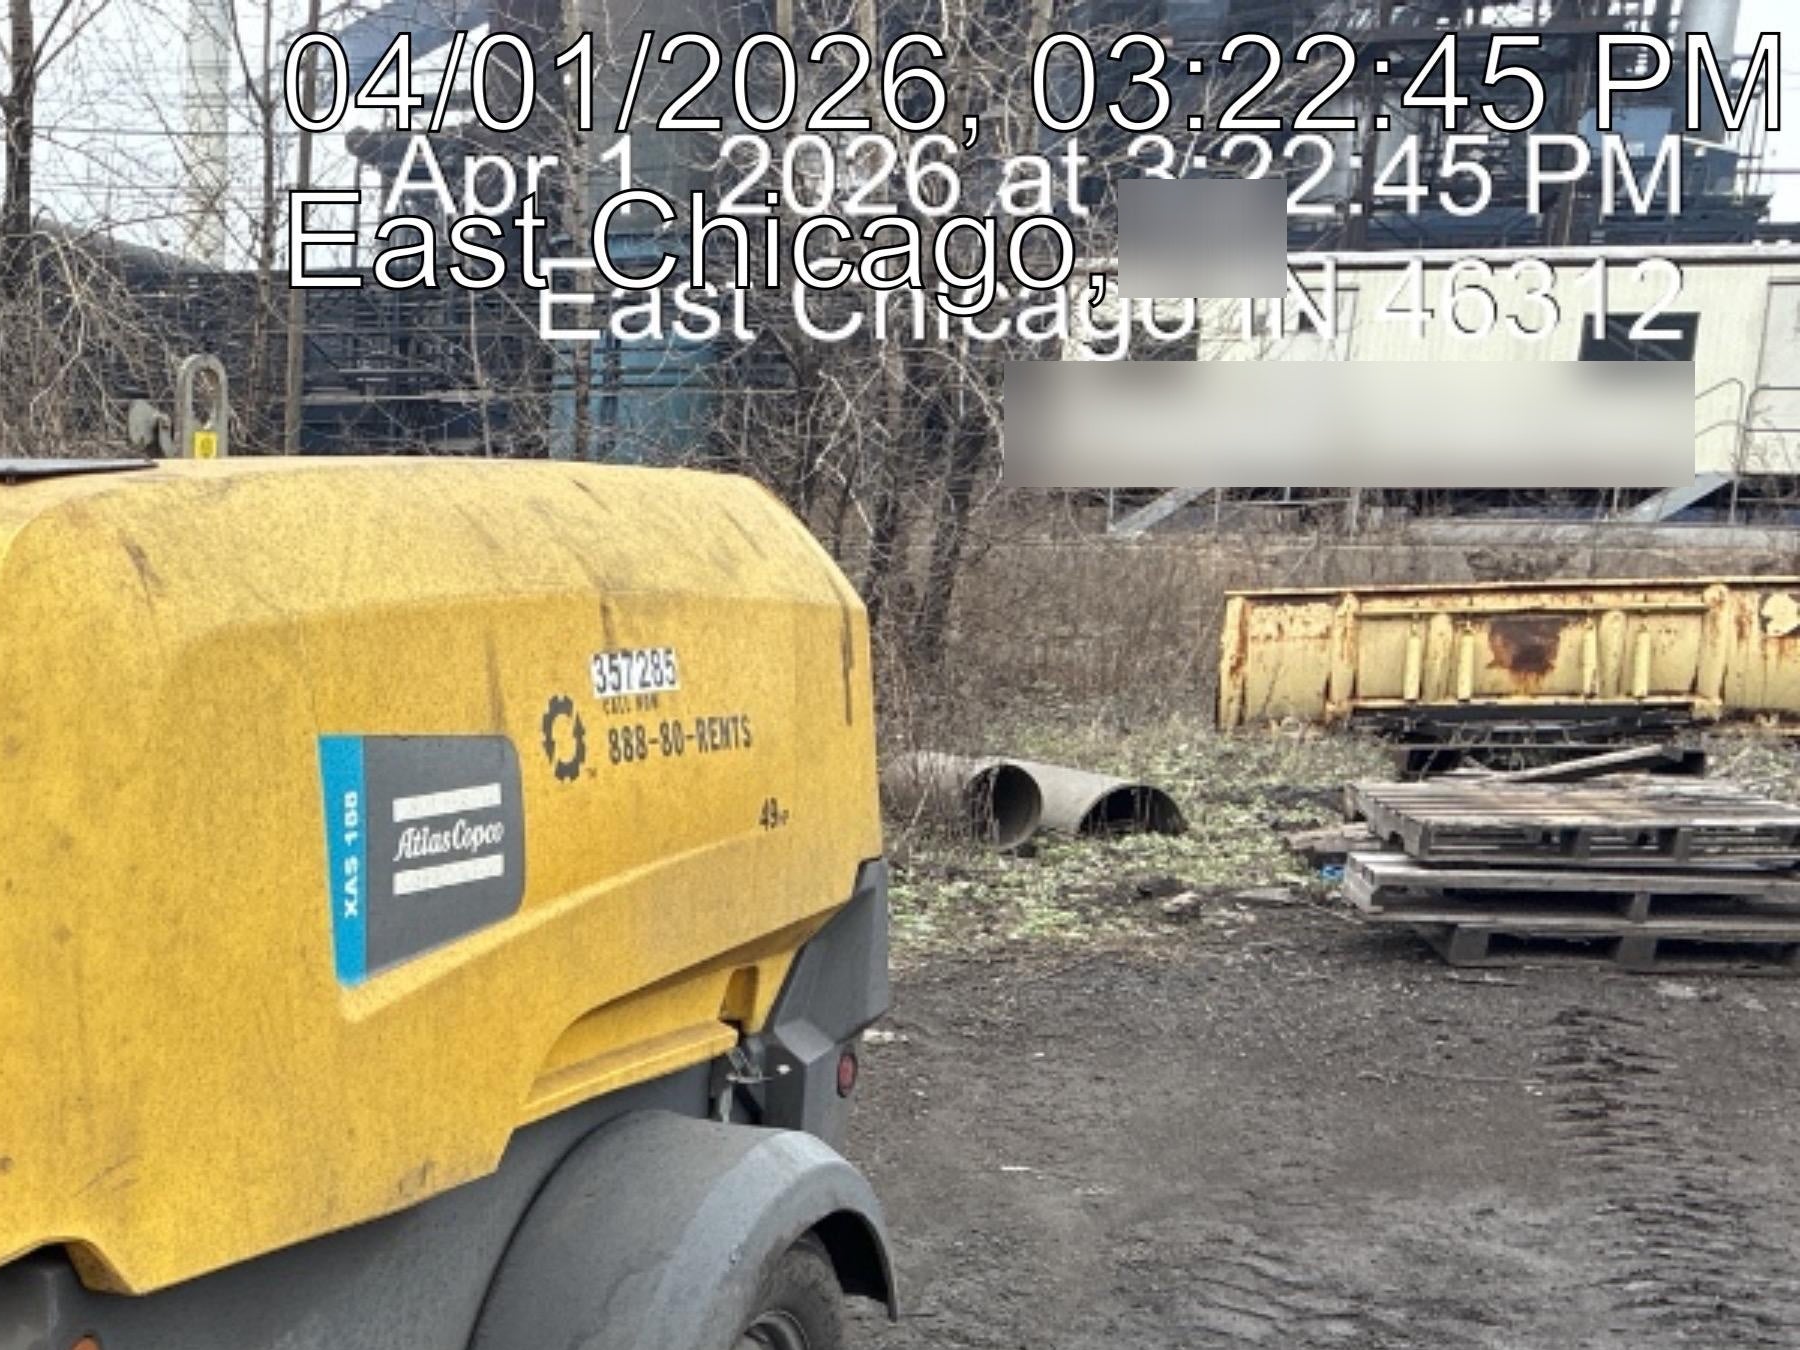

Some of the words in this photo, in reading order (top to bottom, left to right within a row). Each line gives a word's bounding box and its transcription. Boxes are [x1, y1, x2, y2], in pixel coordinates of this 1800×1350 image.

[593, 647, 677, 695] 357285
[607, 714, 754, 766] 888-80-RENTS
[392, 825, 451, 863] Atlas
[451, 817, 505, 854] Copco
[343, 856, 360, 919] XAS
